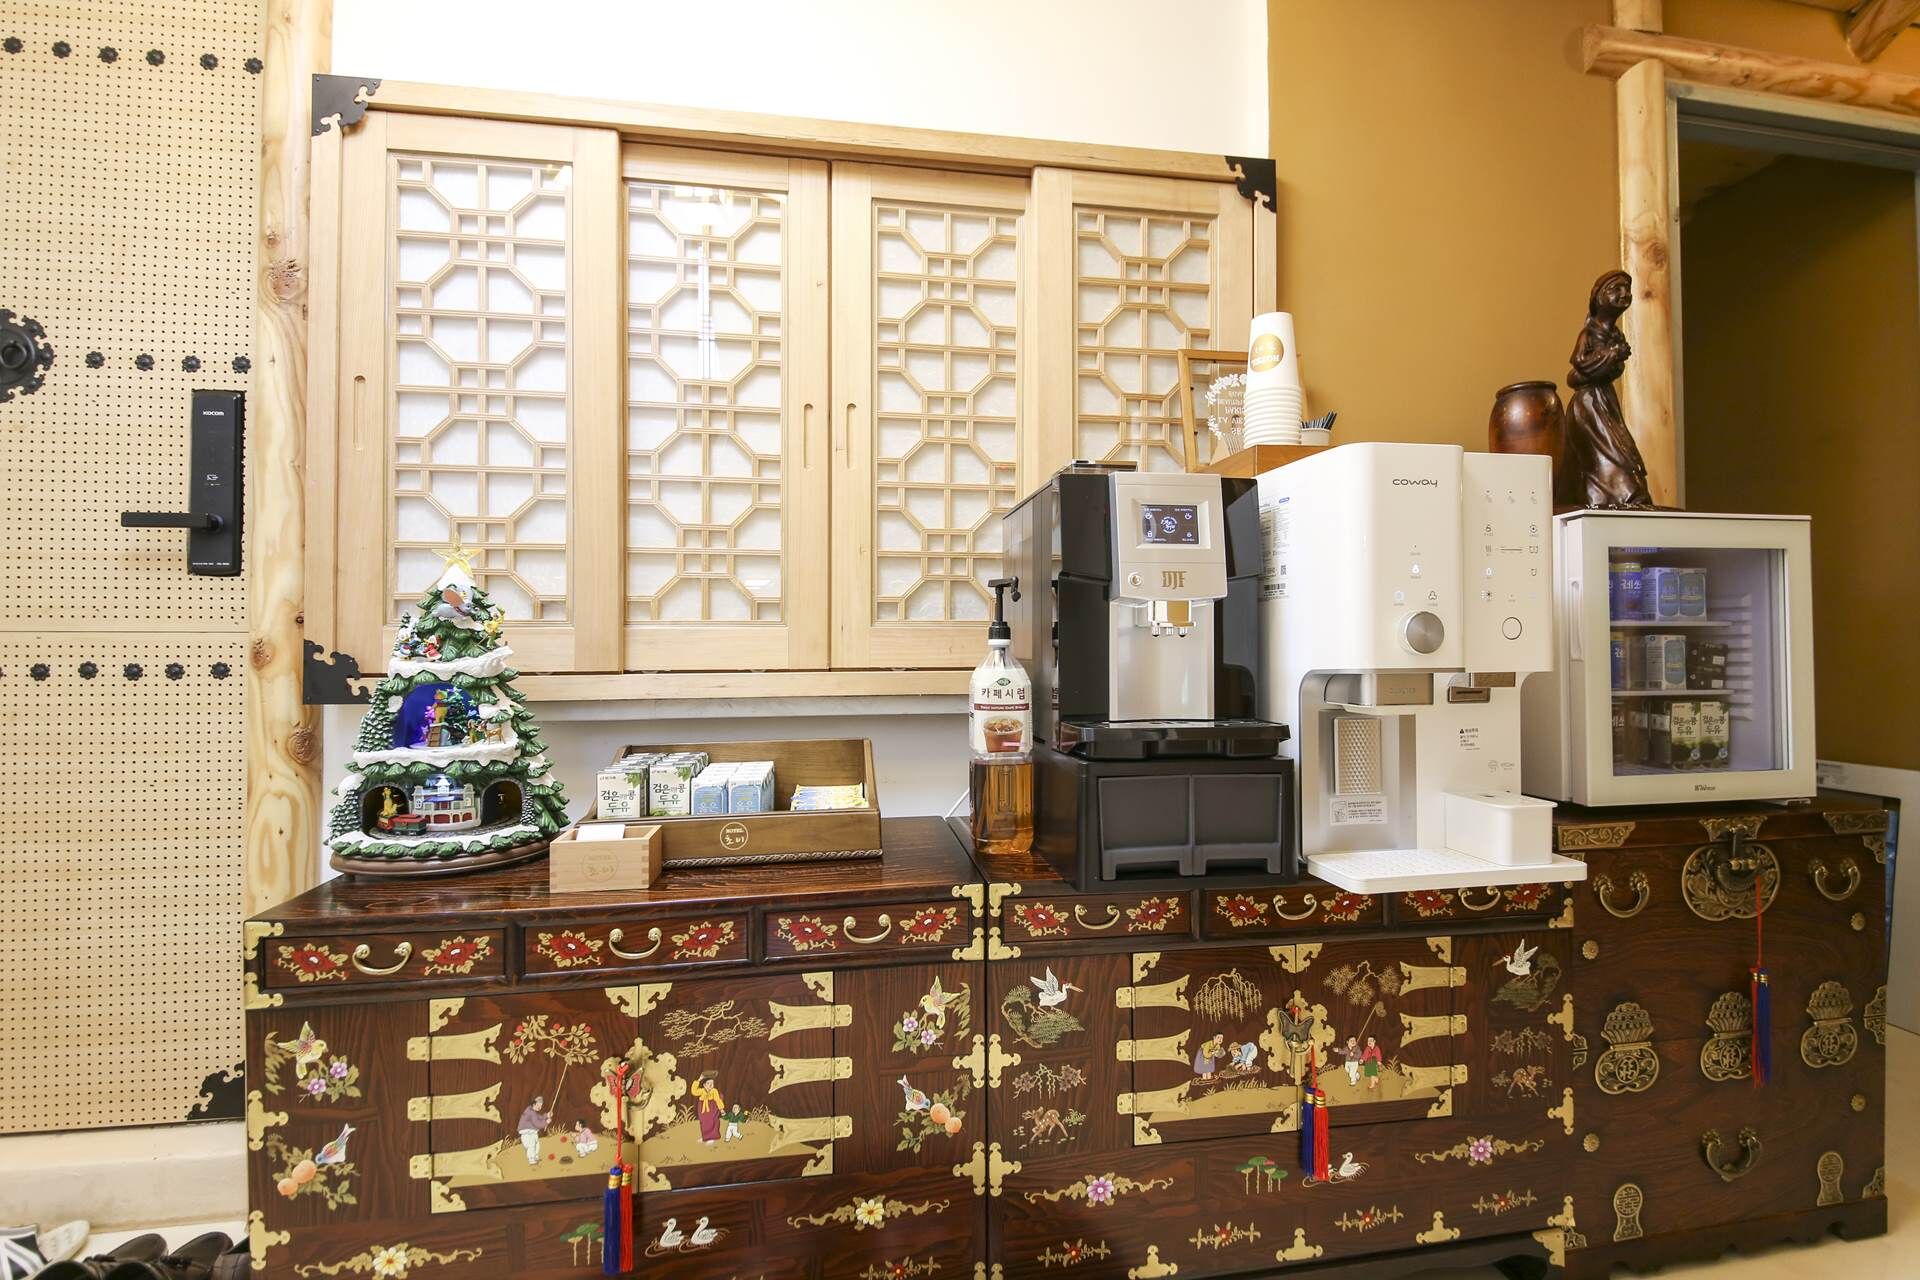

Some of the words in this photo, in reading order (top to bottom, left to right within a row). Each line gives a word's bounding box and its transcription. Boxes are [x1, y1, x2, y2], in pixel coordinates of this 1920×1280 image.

[1392, 478, 1438, 488] coway
[657, 794, 682, 806] 두유
[606, 801, 631, 813] 두유
